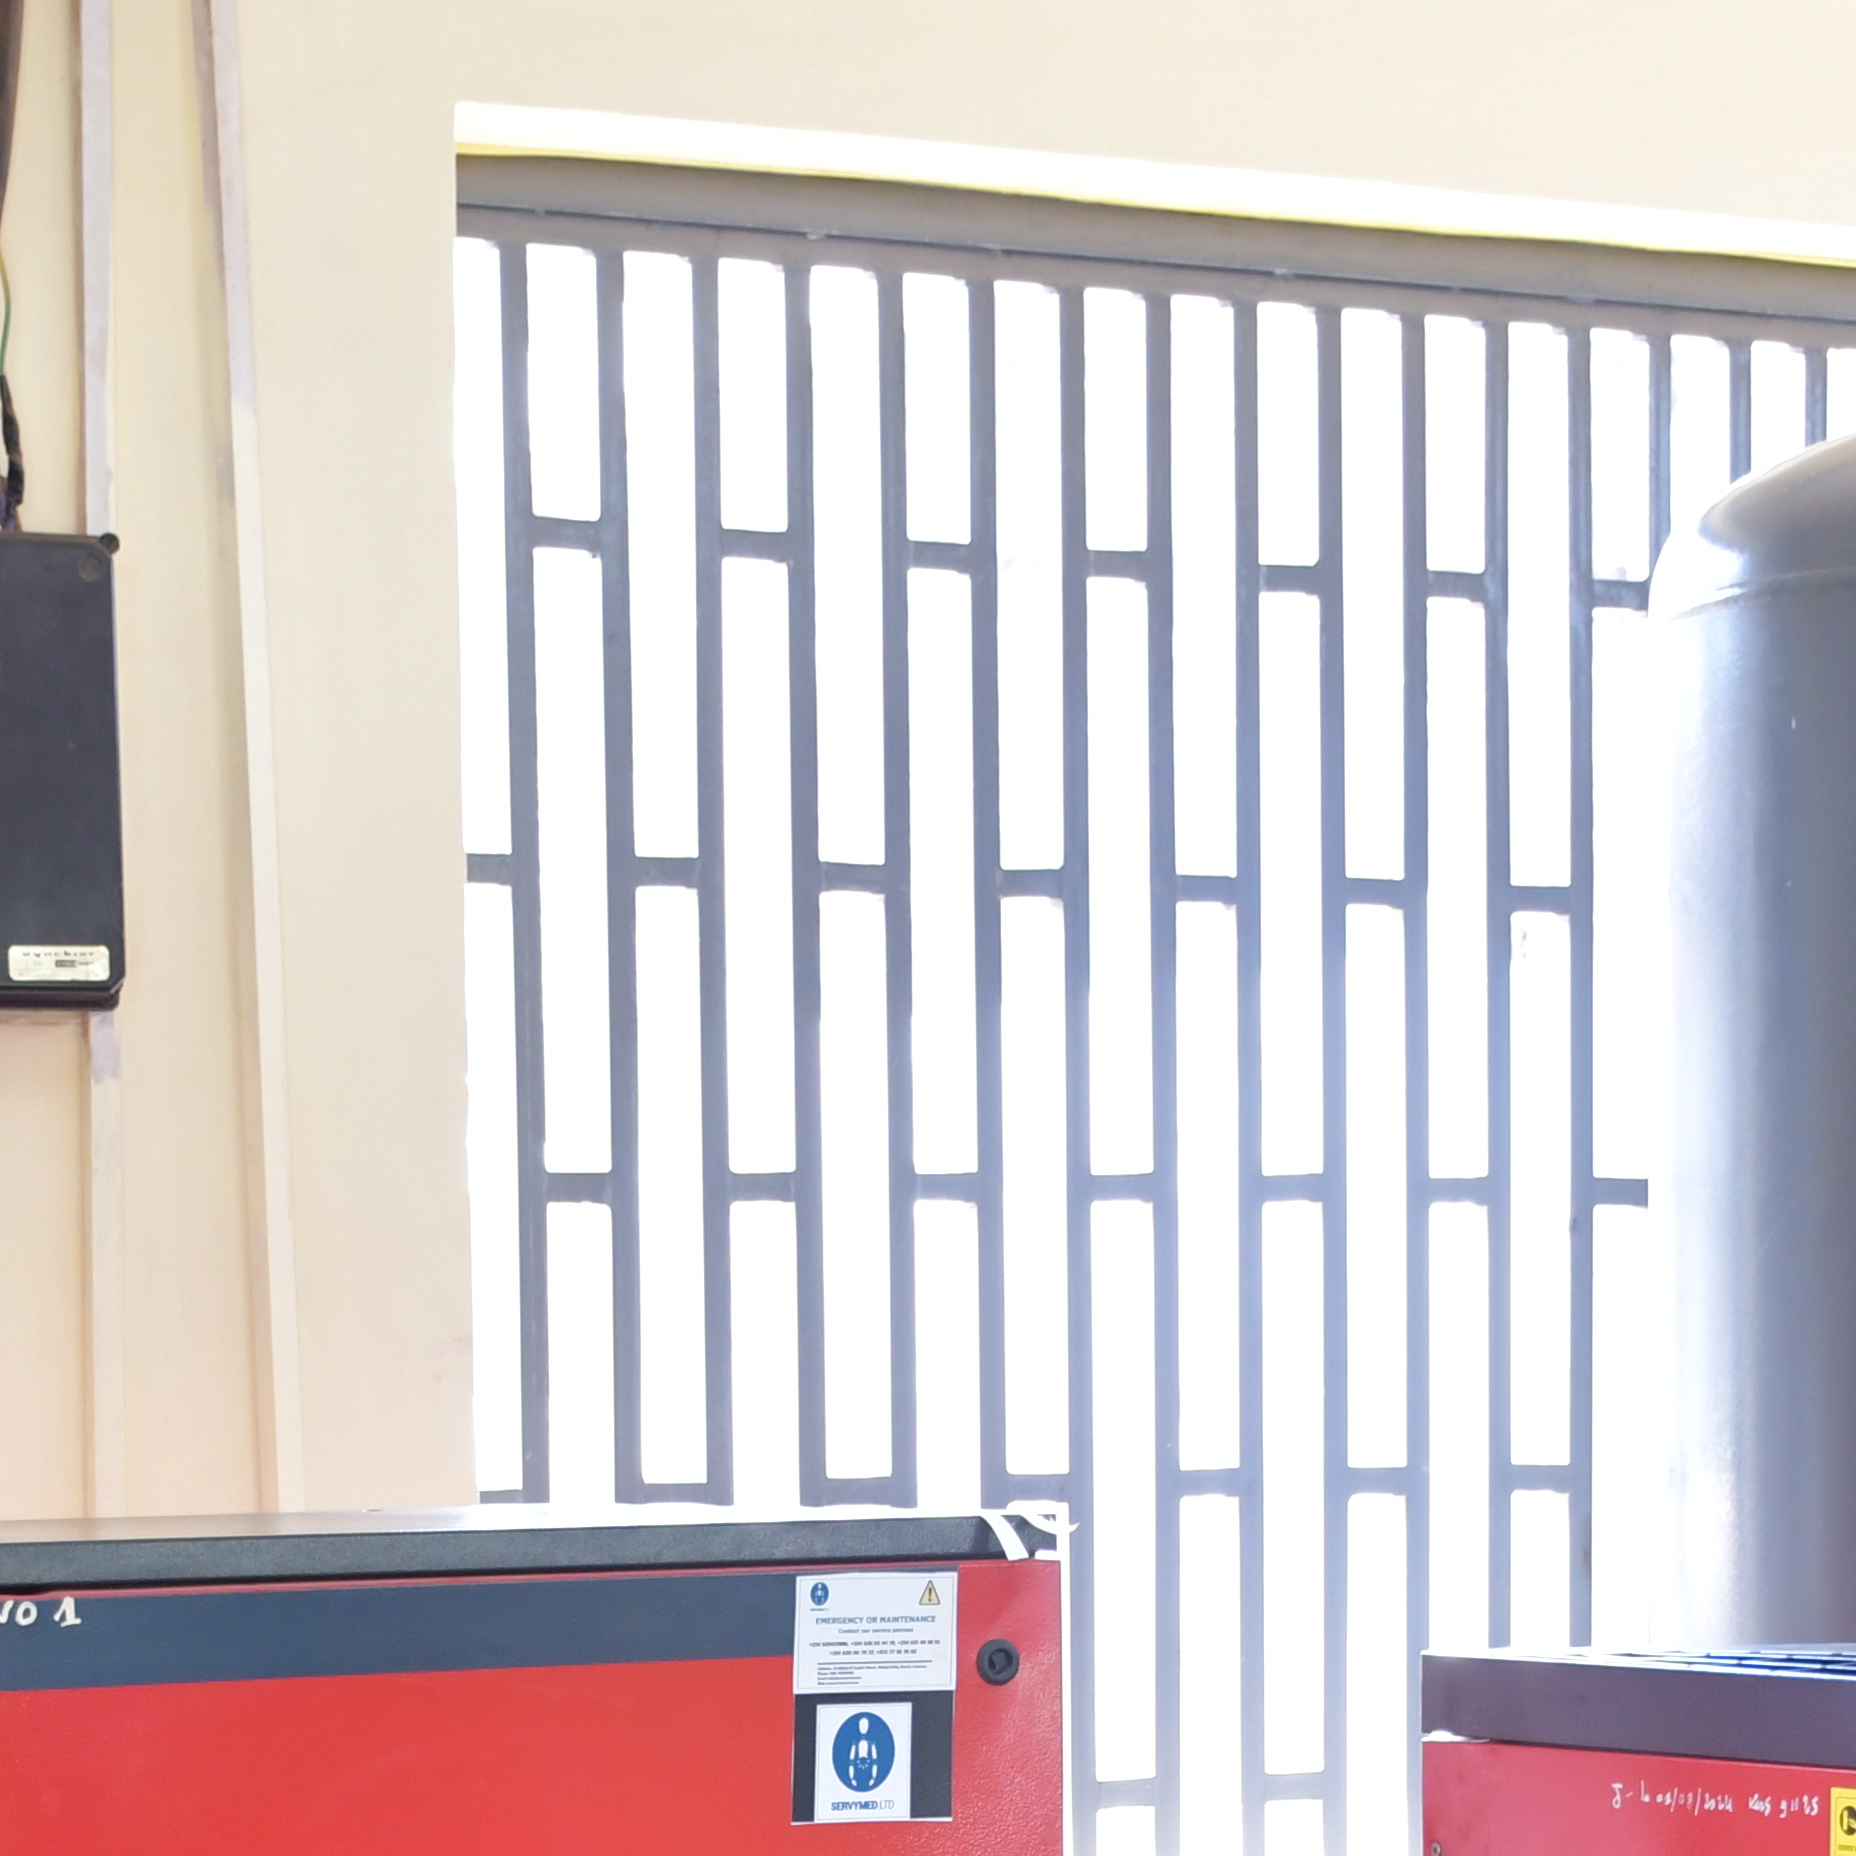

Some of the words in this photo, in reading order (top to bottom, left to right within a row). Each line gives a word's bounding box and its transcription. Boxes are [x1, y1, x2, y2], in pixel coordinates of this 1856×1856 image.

[53, 1596, 82, 1628] 1
[816, 1617, 863, 1625] EMERGENCY
[866, 1616, 877, 1624] OR
[879, 1615, 936, 1624] MAINTENANCE
